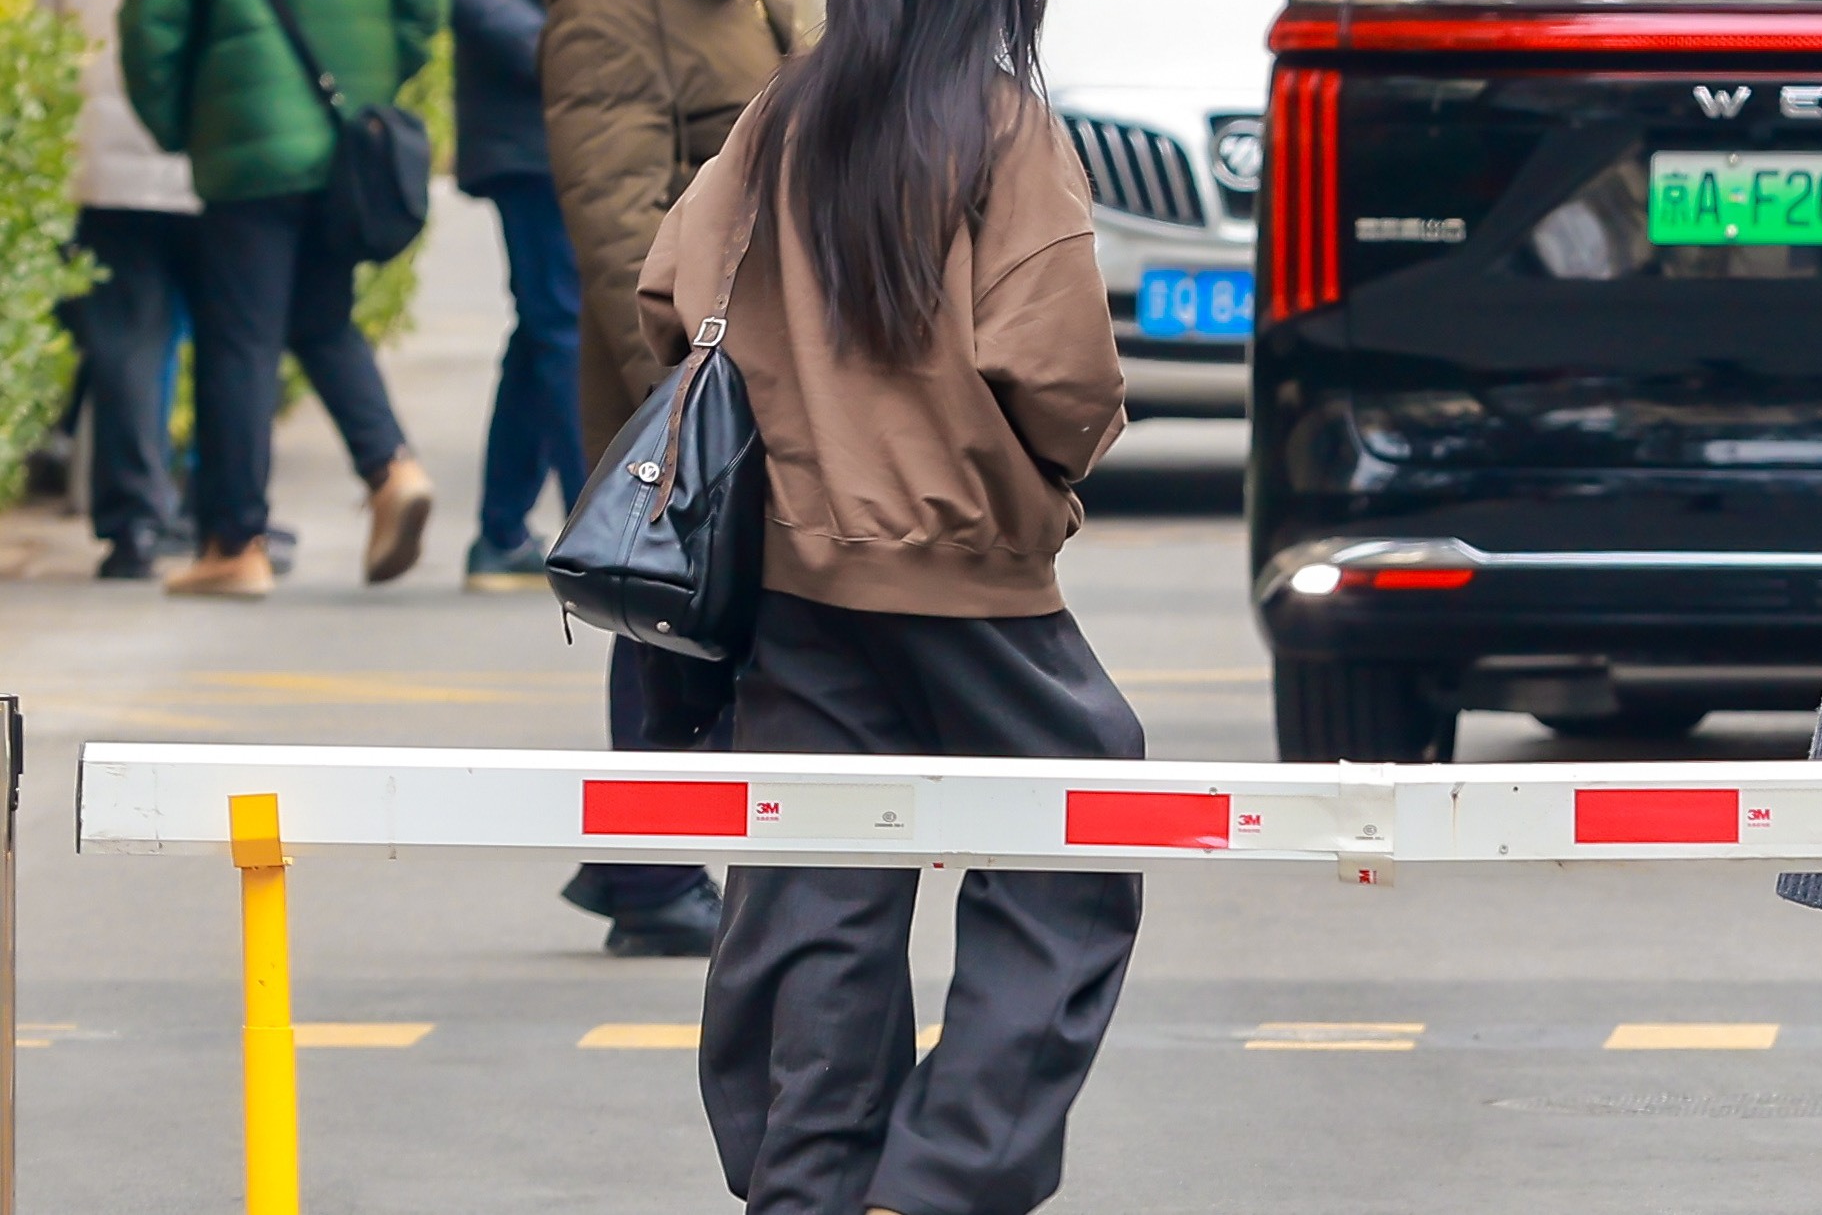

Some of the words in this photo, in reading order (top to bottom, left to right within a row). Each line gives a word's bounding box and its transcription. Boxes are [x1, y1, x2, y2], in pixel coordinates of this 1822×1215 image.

[756, 801, 780, 815] 3M
[1746, 808, 1771, 821] 3M
[1237, 814, 1261, 826] 3M
